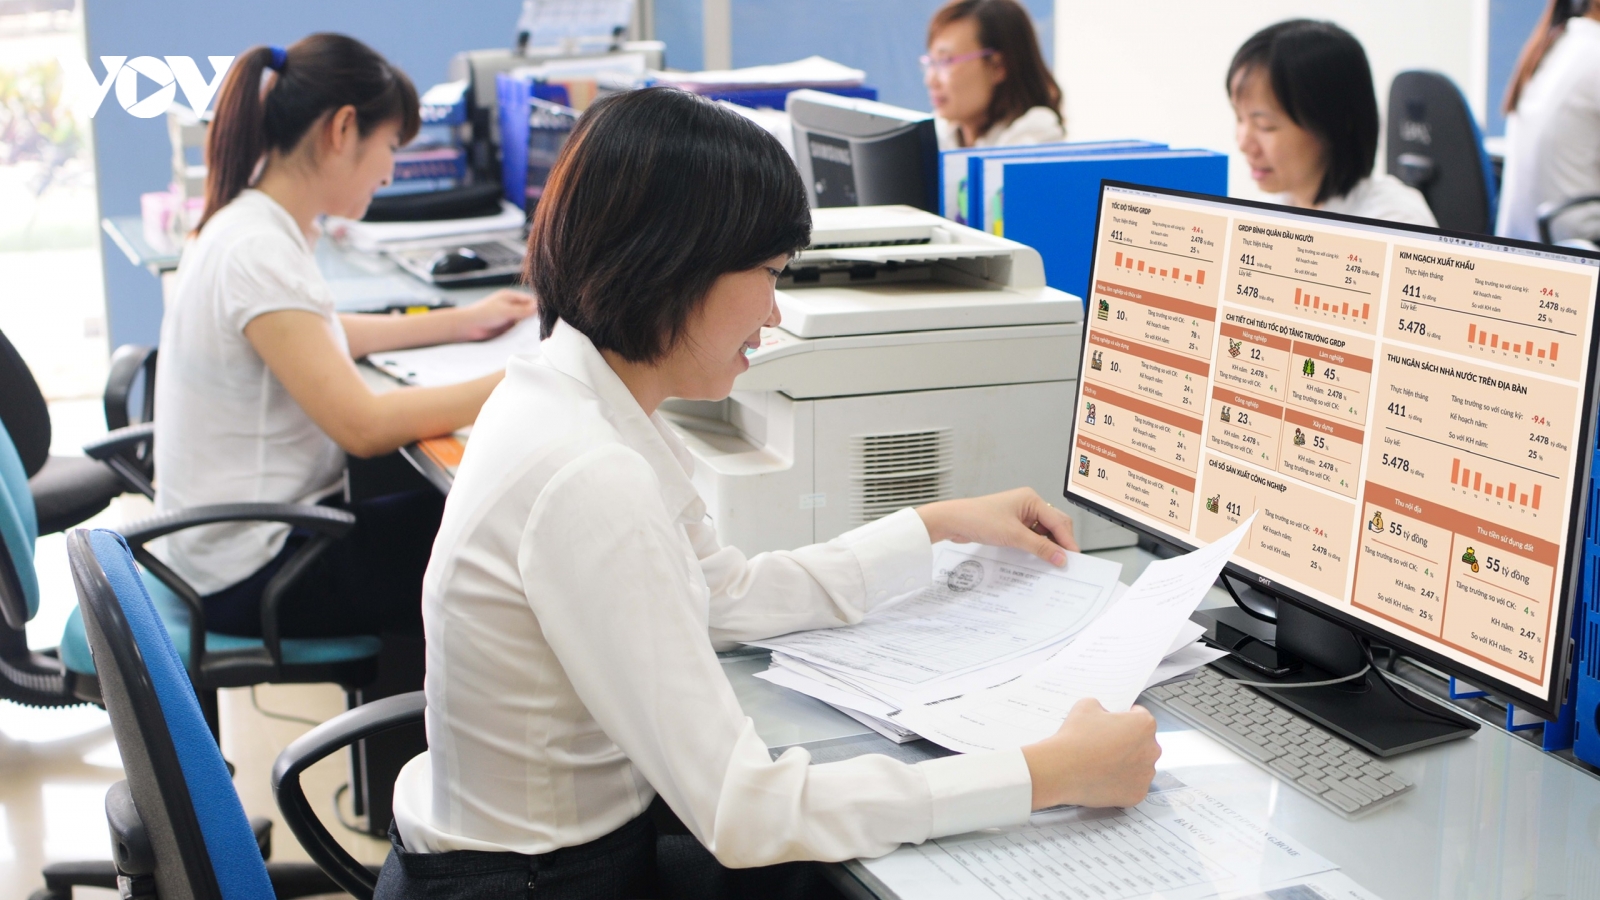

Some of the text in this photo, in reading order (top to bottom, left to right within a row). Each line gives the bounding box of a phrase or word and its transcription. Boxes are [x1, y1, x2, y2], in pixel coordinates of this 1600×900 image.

[1138, 207, 1152, 215] GRDP
[1238, 224, 1253, 232] GRDP
[1110, 230, 1123, 241] 411
[1190, 235, 1204, 244] 2.478
[1240, 253, 1255, 266] 411
[1347, 254, 1358, 262] -9.4
[1399, 251, 1475, 271] KIM NGẠCH XUẤT KHẨU
[1345, 264, 1362, 274] 2.478
[1404, 266, 1418, 276] Thực
[1429, 271, 1444, 282] tháng
[1344, 276, 1352, 285] 25
[1236, 284, 1259, 299] 5.478
[1402, 284, 1421, 298] 411
[1539, 287, 1554, 297] -9.4
[1539, 299, 1559, 311] 2.478
[1116, 310, 1126, 321] 10
[1537, 313, 1547, 322] 25
[1398, 318, 1426, 336] 5.478
[1188, 342, 1195, 350] 25
[1329, 338, 1346, 348] GRDP
[1250, 348, 1261, 360] 12
[1110, 360, 1119, 372] 10
[1250, 368, 1264, 378] 2.478
[1323, 367, 1336, 380] 45
[1387, 353, 1528, 395] THU NGÂN SÁCH NHÀ NƯỚC TRÊN ĐỊA BÀN
[1327, 388, 1343, 400] 2.478
[1390, 384, 1403, 394] Thực
[1414, 391, 1429, 402] tháng
[1182, 396, 1189, 405] 25
[1451, 394, 1464, 406] Tăng
[1387, 402, 1406, 418] 411
[1103, 414, 1113, 426] 10
[1237, 411, 1249, 425] 23
[1531, 415, 1545, 425] -9.4
[1242, 434, 1256, 445] 2.478
[1313, 435, 1325, 449] 55
[1448, 431, 1456, 440] So
[1465, 436, 1475, 444] KH
[1529, 432, 1549, 445] 2.478
[1175, 453, 1182, 461] 25
[1528, 449, 1538, 459] 25
[1318, 460, 1334, 472] 2.478
[1382, 453, 1410, 472] 5.478
[1097, 468, 1106, 479] 10
[1169, 498, 1176, 506] 24
[1395, 498, 1405, 508] Thu
[1168, 509, 1175, 518] 25
[1226, 501, 1241, 517] 411
[1312, 527, 1324, 537] -9.4
[1389, 521, 1402, 536] 55
[1410, 533, 1428, 548] đồng
[1477, 526, 1488, 536] Thu
[1312, 543, 1328, 556] 2.478
[1310, 560, 1318, 569] 25
[1424, 568, 1429, 576] 4
[1485, 556, 1501, 573] 55
[1510, 569, 1530, 586] đồng
[1395, 578, 1404, 588] KH
[1420, 588, 1435, 599] 2.47
[1392, 598, 1402, 608] KH
[1418, 609, 1428, 619] 25
[1523, 606, 1529, 615] 4
[1490, 617, 1501, 627] KH
[1520, 627, 1536, 640] 2.47
[1488, 638, 1498, 648] KH
[1518, 650, 1528, 661] 25
